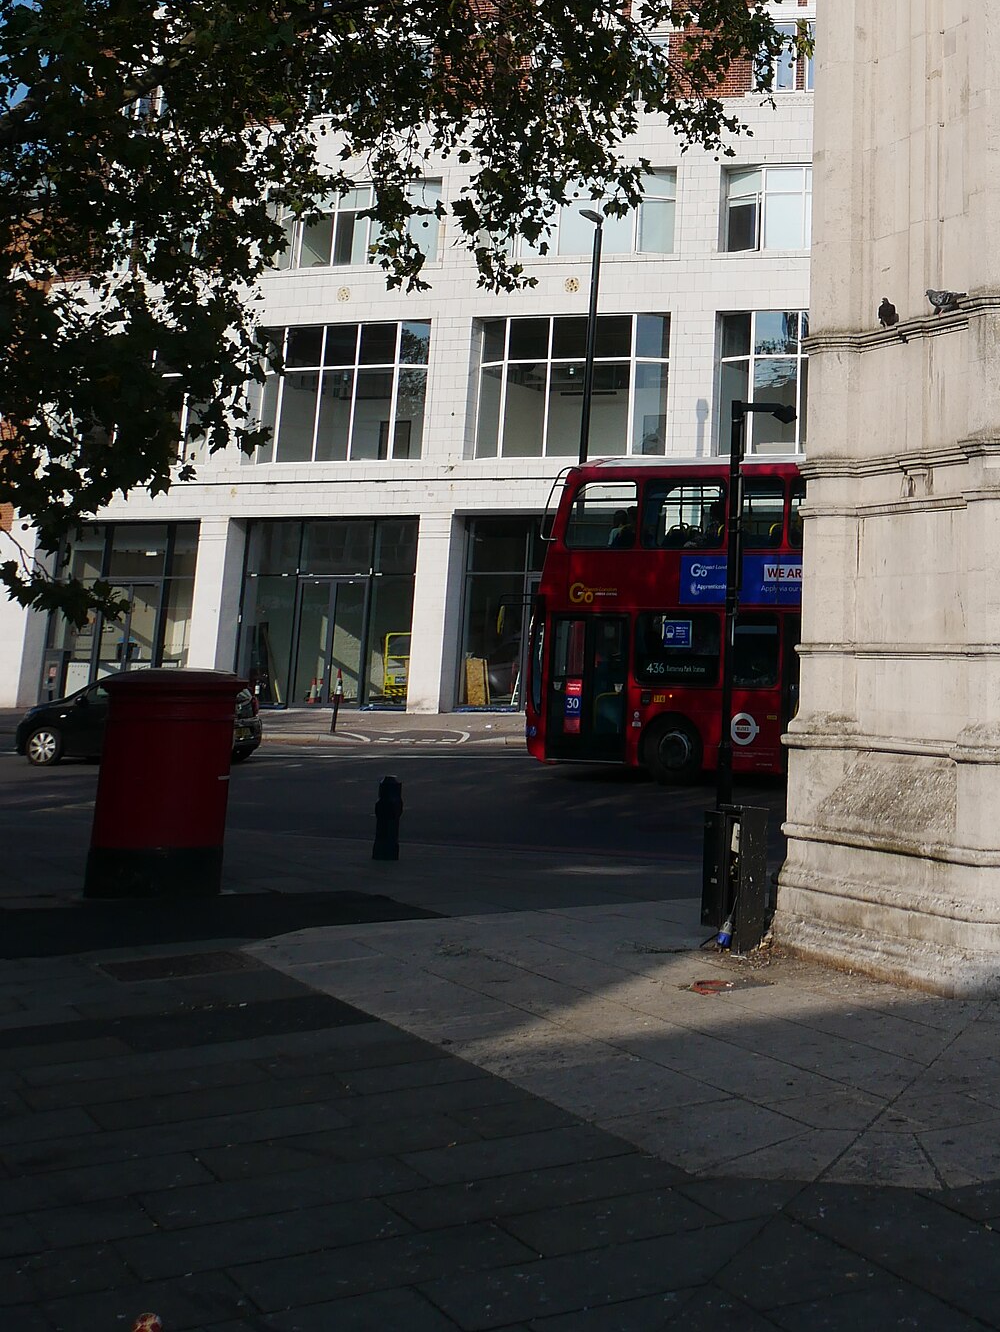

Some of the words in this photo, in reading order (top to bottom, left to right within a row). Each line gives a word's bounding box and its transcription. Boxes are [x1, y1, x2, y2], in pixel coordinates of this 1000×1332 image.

[691, 563, 708, 578] Go
[767, 568, 784, 579] WE
[787, 568, 802, 579] AR
[570, 582, 594, 604] Go
[761, 584, 778, 594] Apply
[780, 584, 788, 592] via
[646, 662, 665, 674] 436
[566, 697, 579, 709] 30
